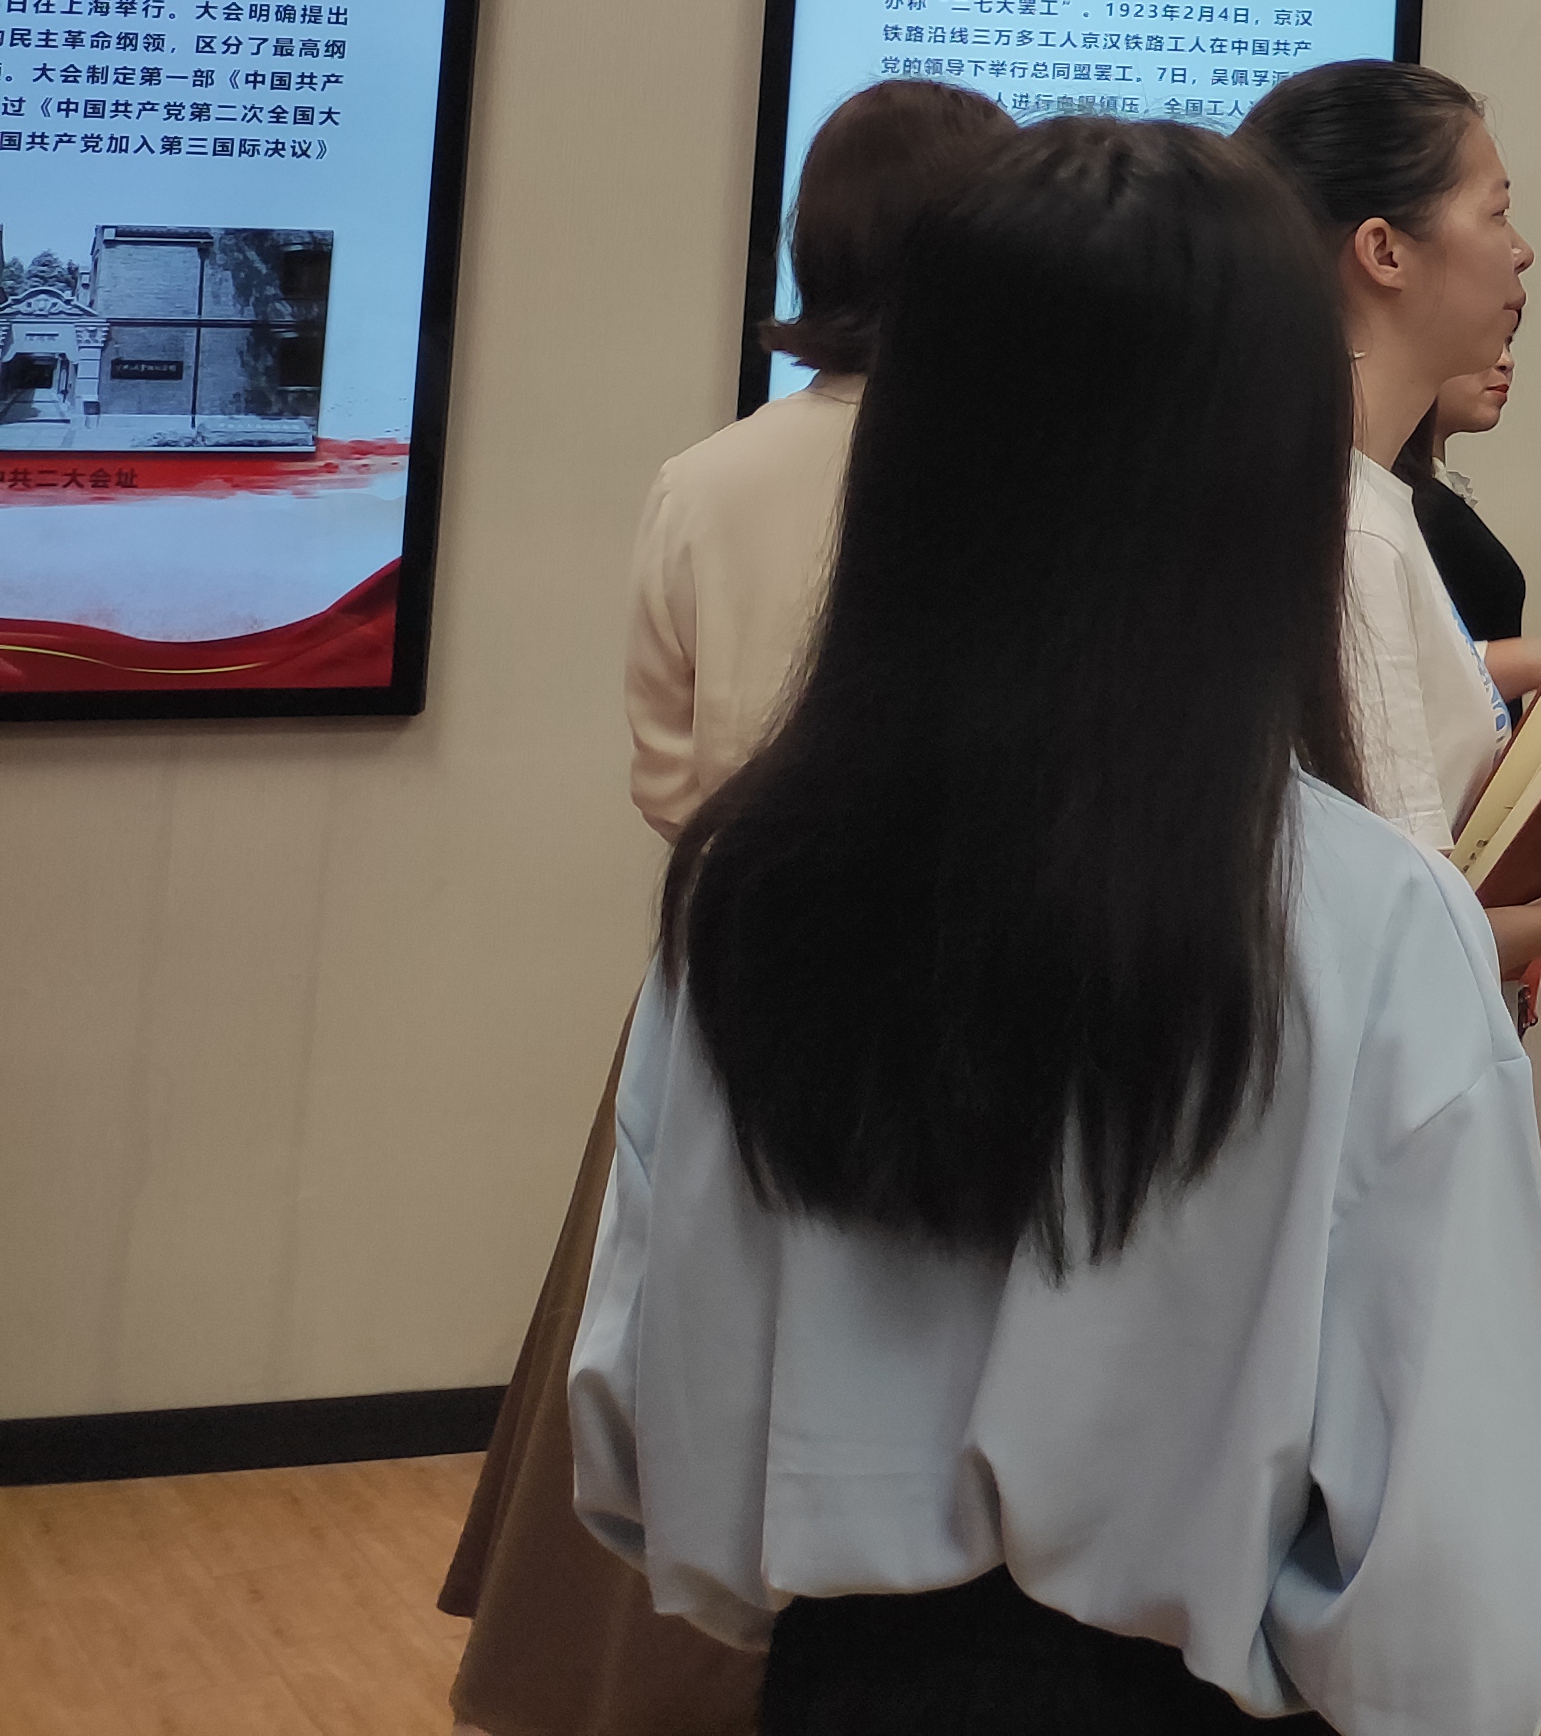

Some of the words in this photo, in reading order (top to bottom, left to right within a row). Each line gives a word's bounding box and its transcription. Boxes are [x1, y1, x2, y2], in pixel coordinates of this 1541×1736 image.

[0, 28, 347, 60] 民主革命纲领，区分了最高纲
[883, 24, 1312, 57] 铁路沿线三万多工人京汉铁路工人在中国共产
[0, 62, 344, 93] 。大会制定第一部《中国共产
[881, 55, 1302, 86] 党的领导下举行总同盟罢工。7日，吴佩孚派
[1, 96, 341, 127] 过《中国共产党第二次全国大
[0, 130, 328, 161] 国共产党加入第三国际决议》
[0, 467, 138, 489] 共二大会址
